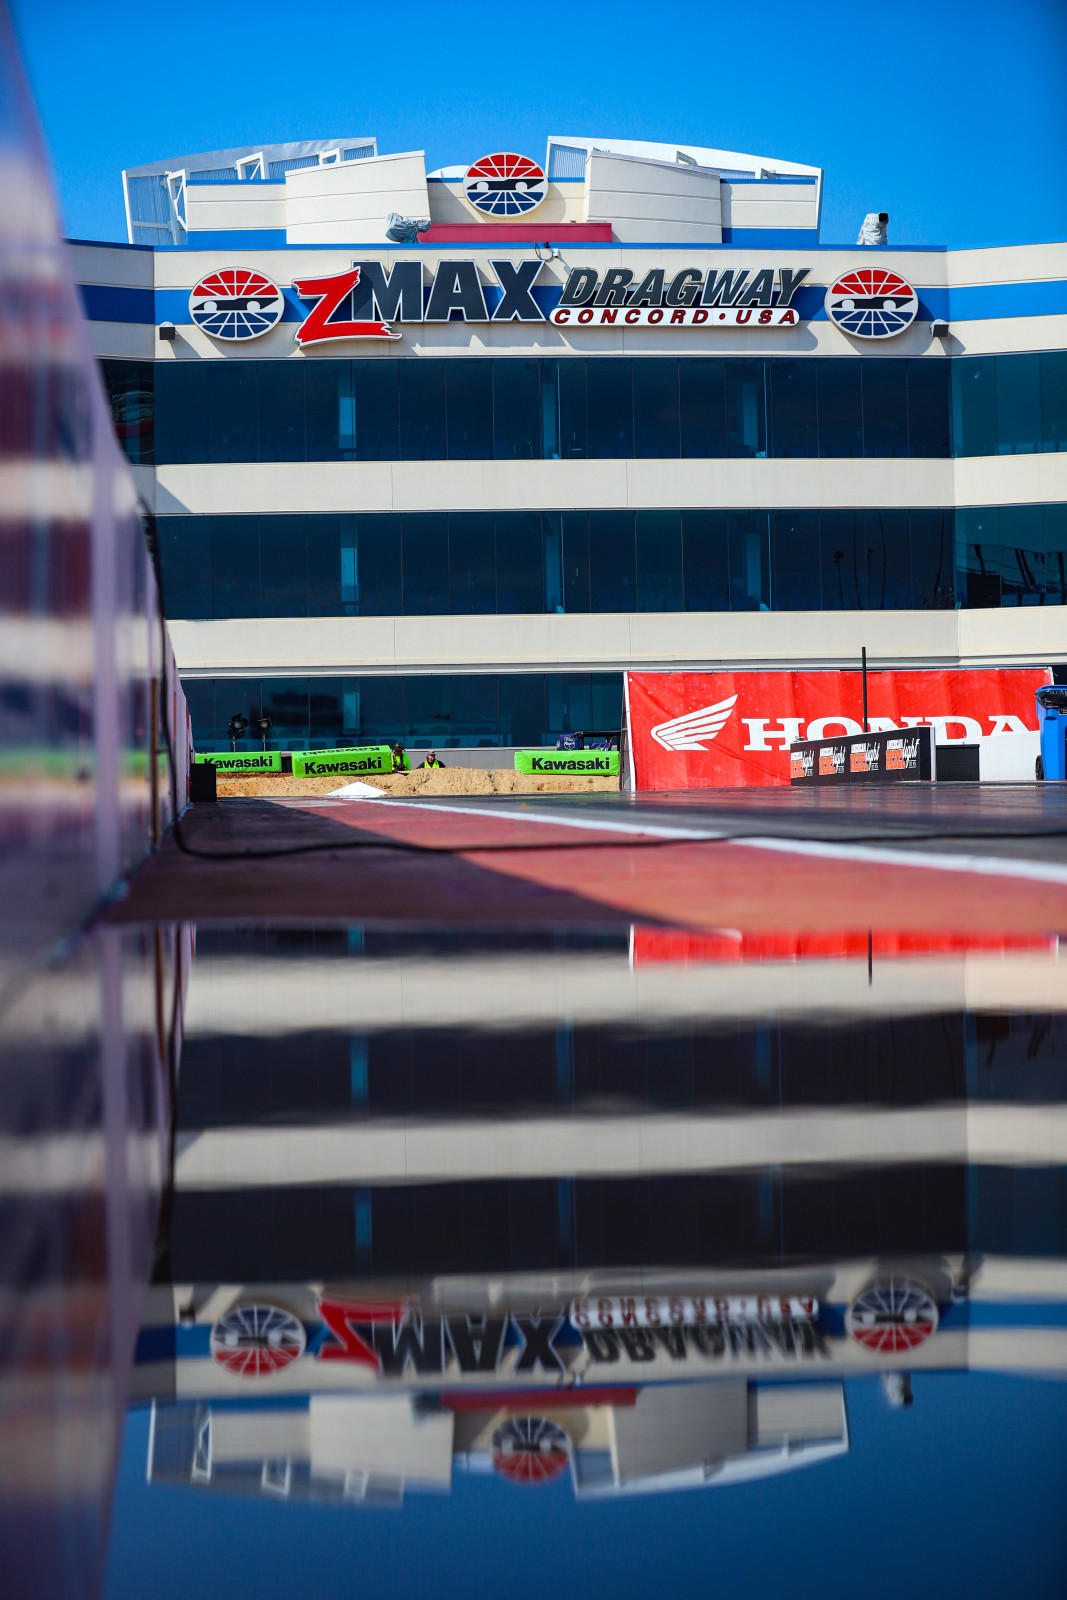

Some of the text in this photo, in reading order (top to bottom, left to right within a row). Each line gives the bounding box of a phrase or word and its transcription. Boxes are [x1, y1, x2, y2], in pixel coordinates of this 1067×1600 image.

[558, 267, 814, 307] DRAGWAY
[204, 756, 273, 769] Kawasaki
[304, 757, 382, 775] Kawasaki
[532, 757, 609, 770] Kawasaki
